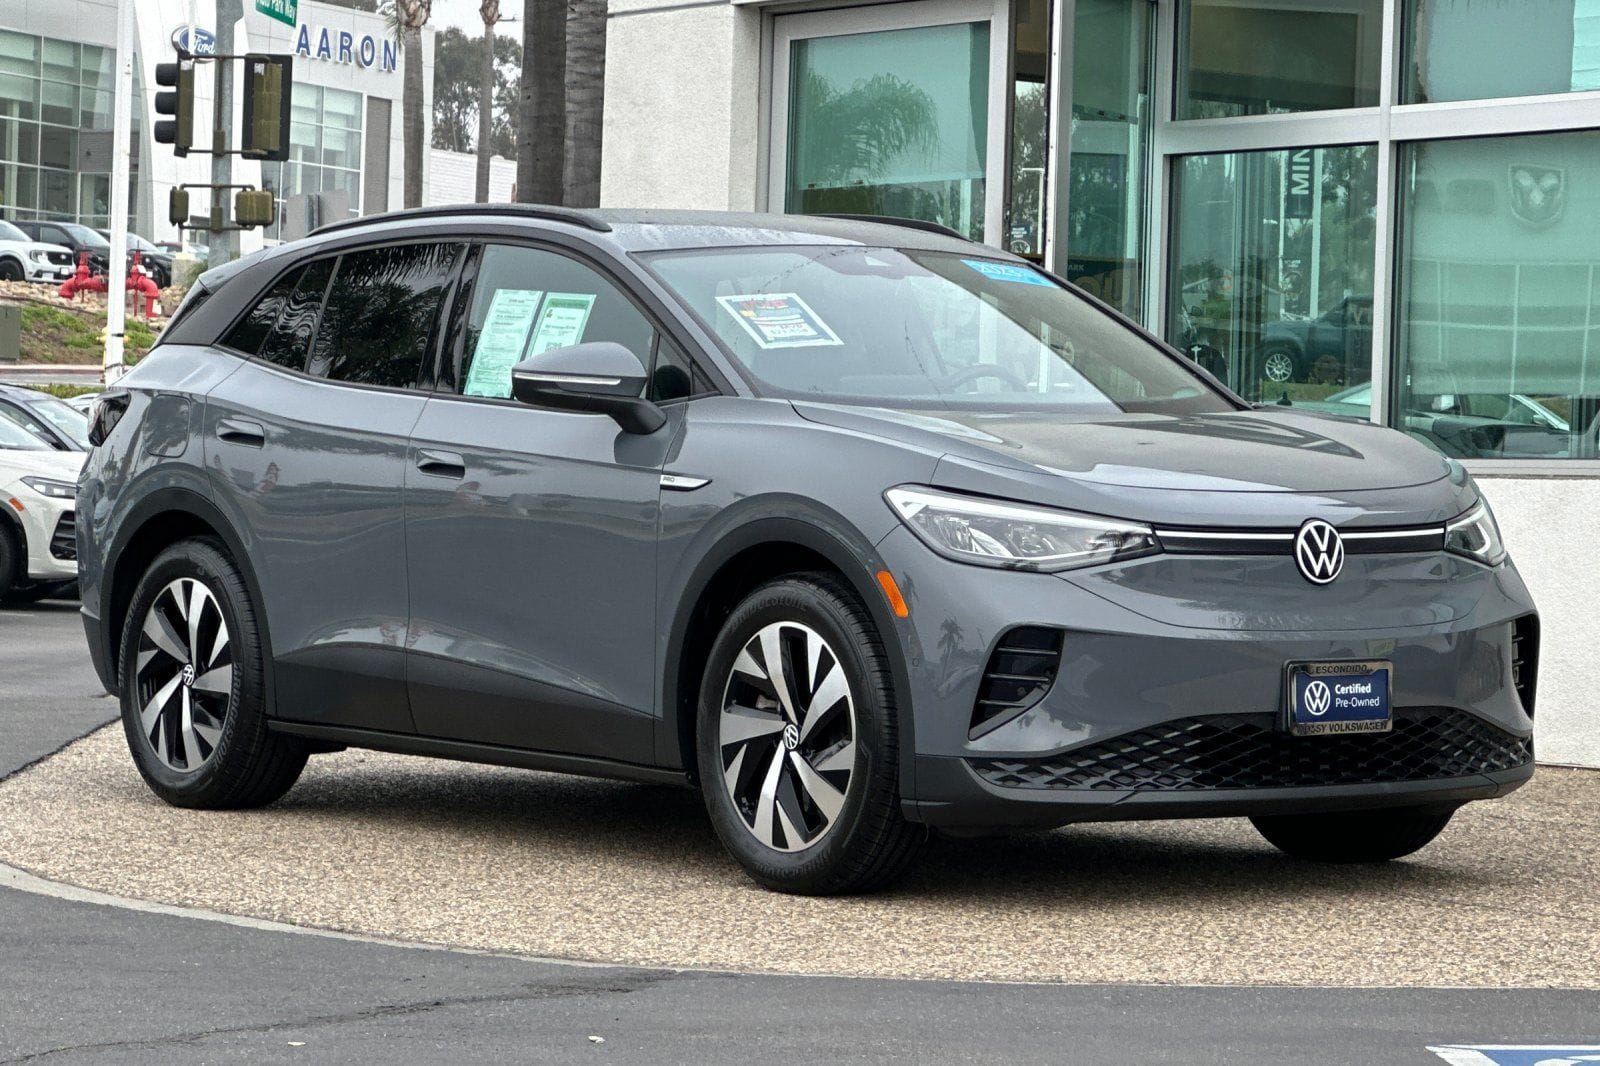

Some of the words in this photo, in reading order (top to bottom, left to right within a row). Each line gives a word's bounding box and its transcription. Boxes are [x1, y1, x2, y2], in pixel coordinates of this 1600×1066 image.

[296, 23, 397, 71] AARON
[1315, 664, 1368, 674] ESCONDIDO
[1335, 683, 1371, 694] Certified
[1335, 696, 1380, 708] Pre-Owned
[1329, 720, 1388, 733] VOLKSWAGEN
